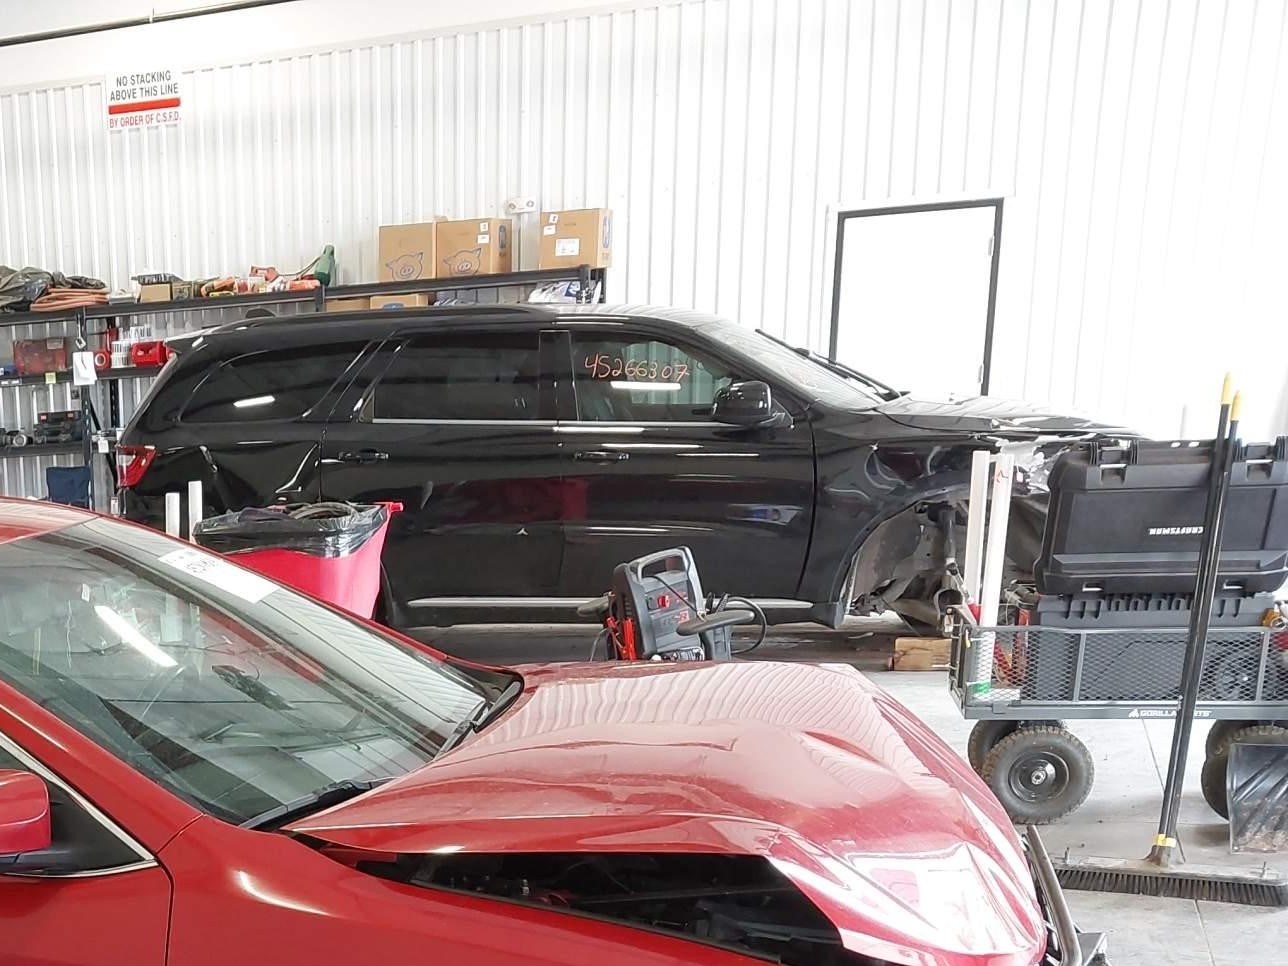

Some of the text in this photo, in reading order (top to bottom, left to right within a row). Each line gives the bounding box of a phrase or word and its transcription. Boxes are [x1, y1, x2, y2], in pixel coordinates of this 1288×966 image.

[116, 70, 172, 88] NO STACKING
[110, 82, 179, 101] ABOVE THIS LINE
[109, 117, 119, 129] BY
[120, 115, 144, 127] ORDER
[145, 113, 154, 125] OF
[584, 353, 690, 382] 45266307
